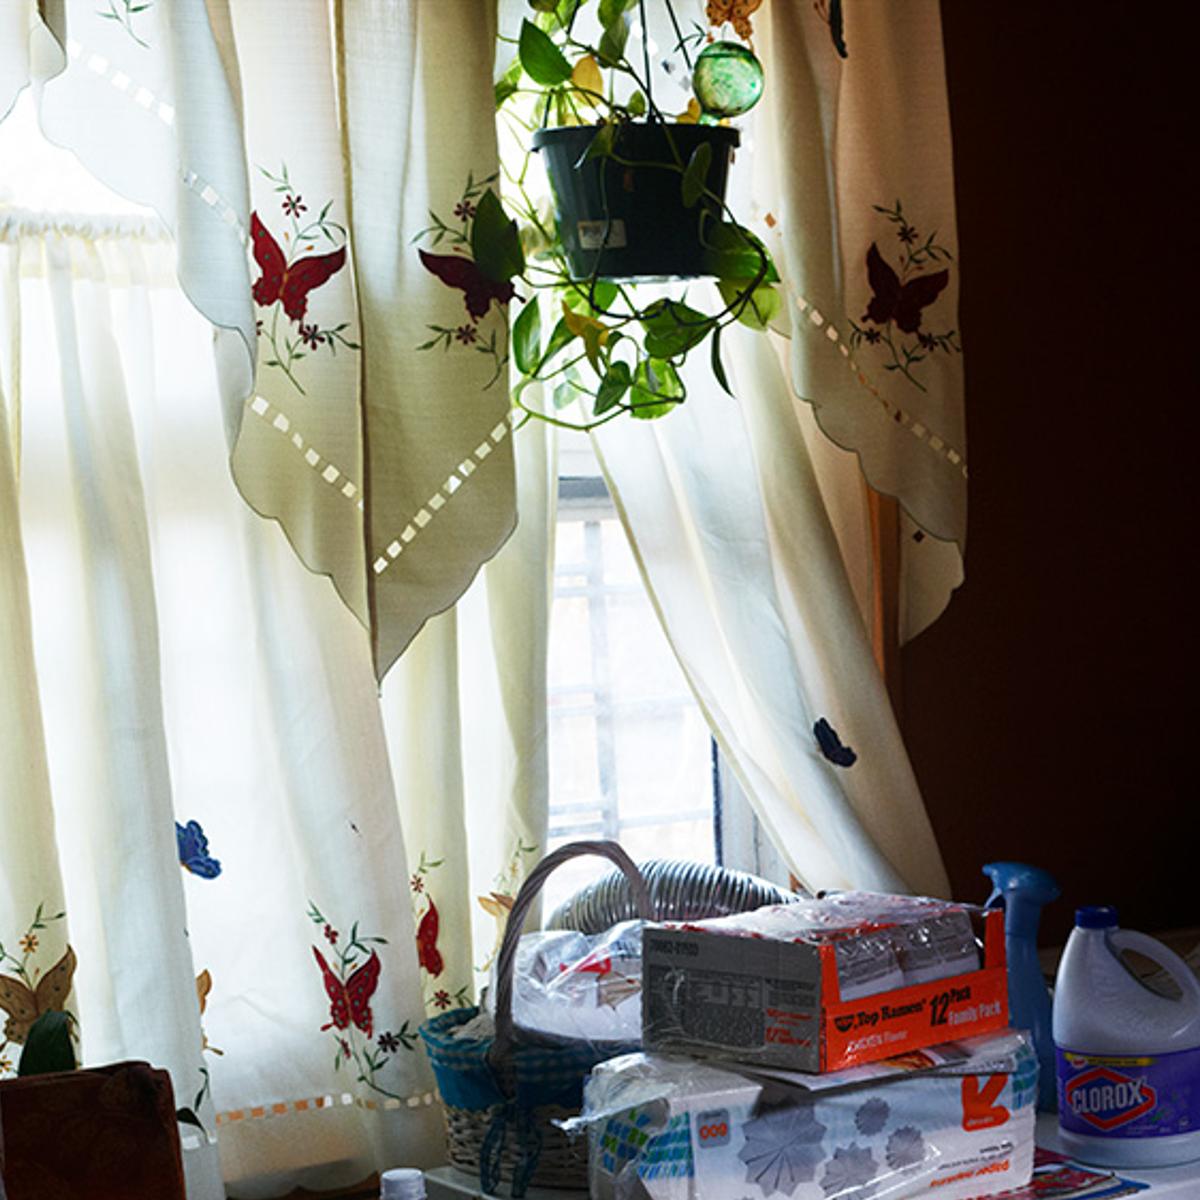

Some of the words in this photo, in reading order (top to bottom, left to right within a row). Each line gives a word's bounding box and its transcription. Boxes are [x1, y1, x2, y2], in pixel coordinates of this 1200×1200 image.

[854, 1011, 880, 1029] Top
[929, 992, 949, 1027] 12
[1072, 1077, 1145, 1115] CLOROX
